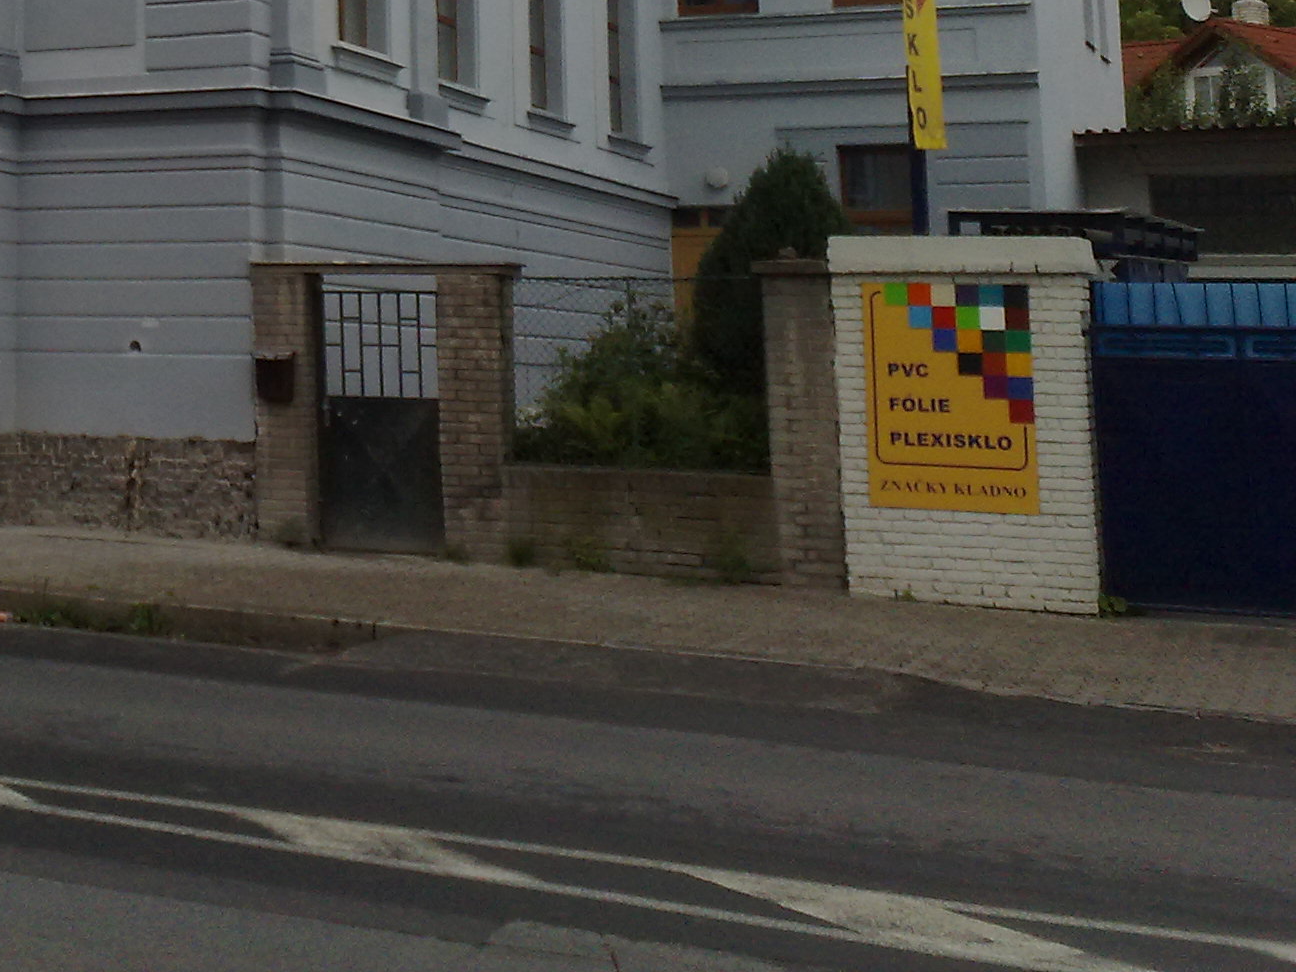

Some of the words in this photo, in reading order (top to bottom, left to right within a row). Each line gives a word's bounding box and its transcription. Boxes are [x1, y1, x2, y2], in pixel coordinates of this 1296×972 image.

[887, 363, 929, 378] PVC
[889, 394, 951, 413] FÓLIE
[890, 432, 1013, 451] PLEXISKLO
[879, 478, 947, 495] ZNAČKY
[953, 483, 1027, 499] KLADNO
